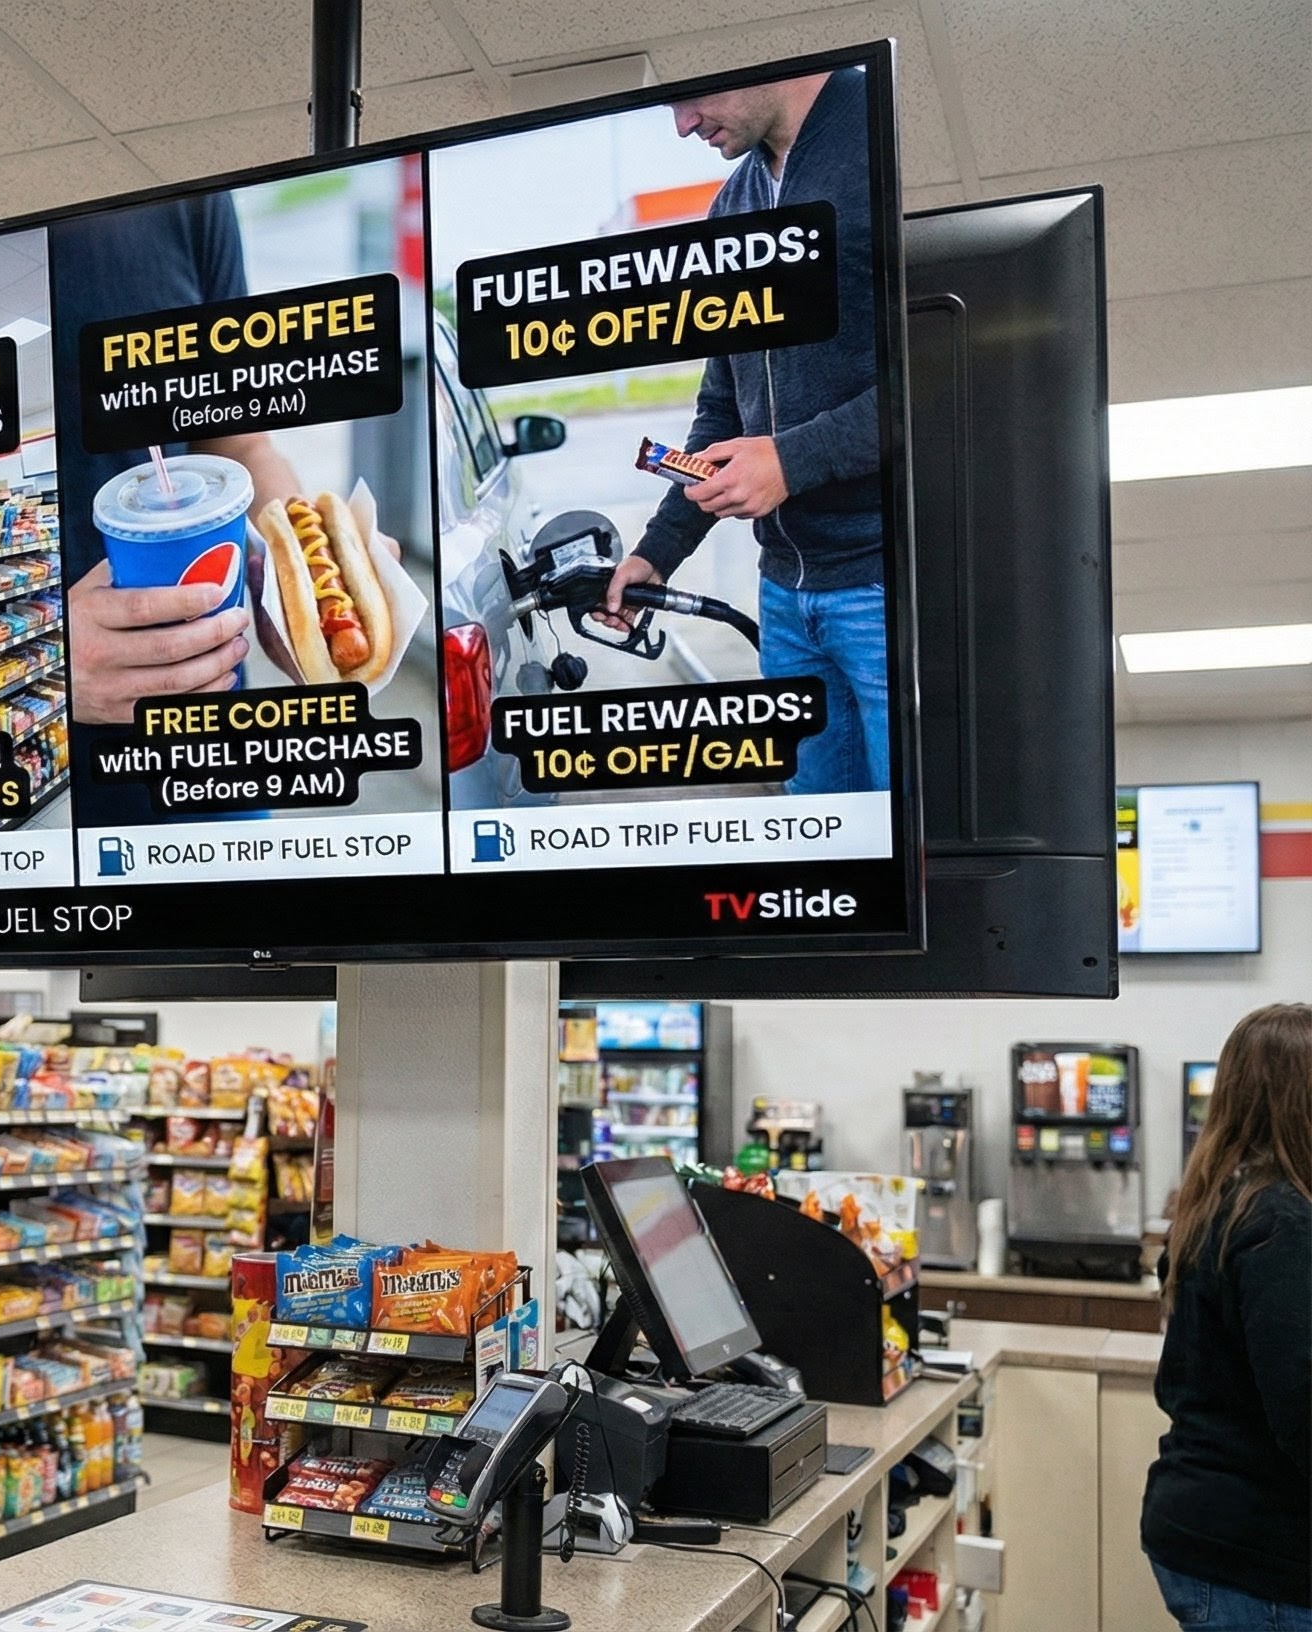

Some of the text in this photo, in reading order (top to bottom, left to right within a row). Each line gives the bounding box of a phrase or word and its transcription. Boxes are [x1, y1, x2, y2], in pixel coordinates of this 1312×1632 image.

[473, 225, 820, 311] FUEL REWARDS:
[103, 294, 375, 372] FREE COFFEE
[505, 287, 785, 359] 10¢ OFF/GAL
[101, 347, 379, 411] with FUEL PURCHASE
[172, 389, 306, 432] (Before 9 AM)
[146, 695, 357, 736] FREE COFFEE
[505, 692, 812, 739] FUEL REWARDS:
[99, 731, 410, 773] with FUEL PURCHASE
[533, 734, 783, 779] 10¢ OFF/GAL
[161, 767, 345, 807] (Before 9 AM)
[148, 835, 411, 865] ROAD TRIP FUEL STOP
[530, 816, 842, 850] ROAD TRIP FUEL STOP
[54, 905, 132, 933] STOP
